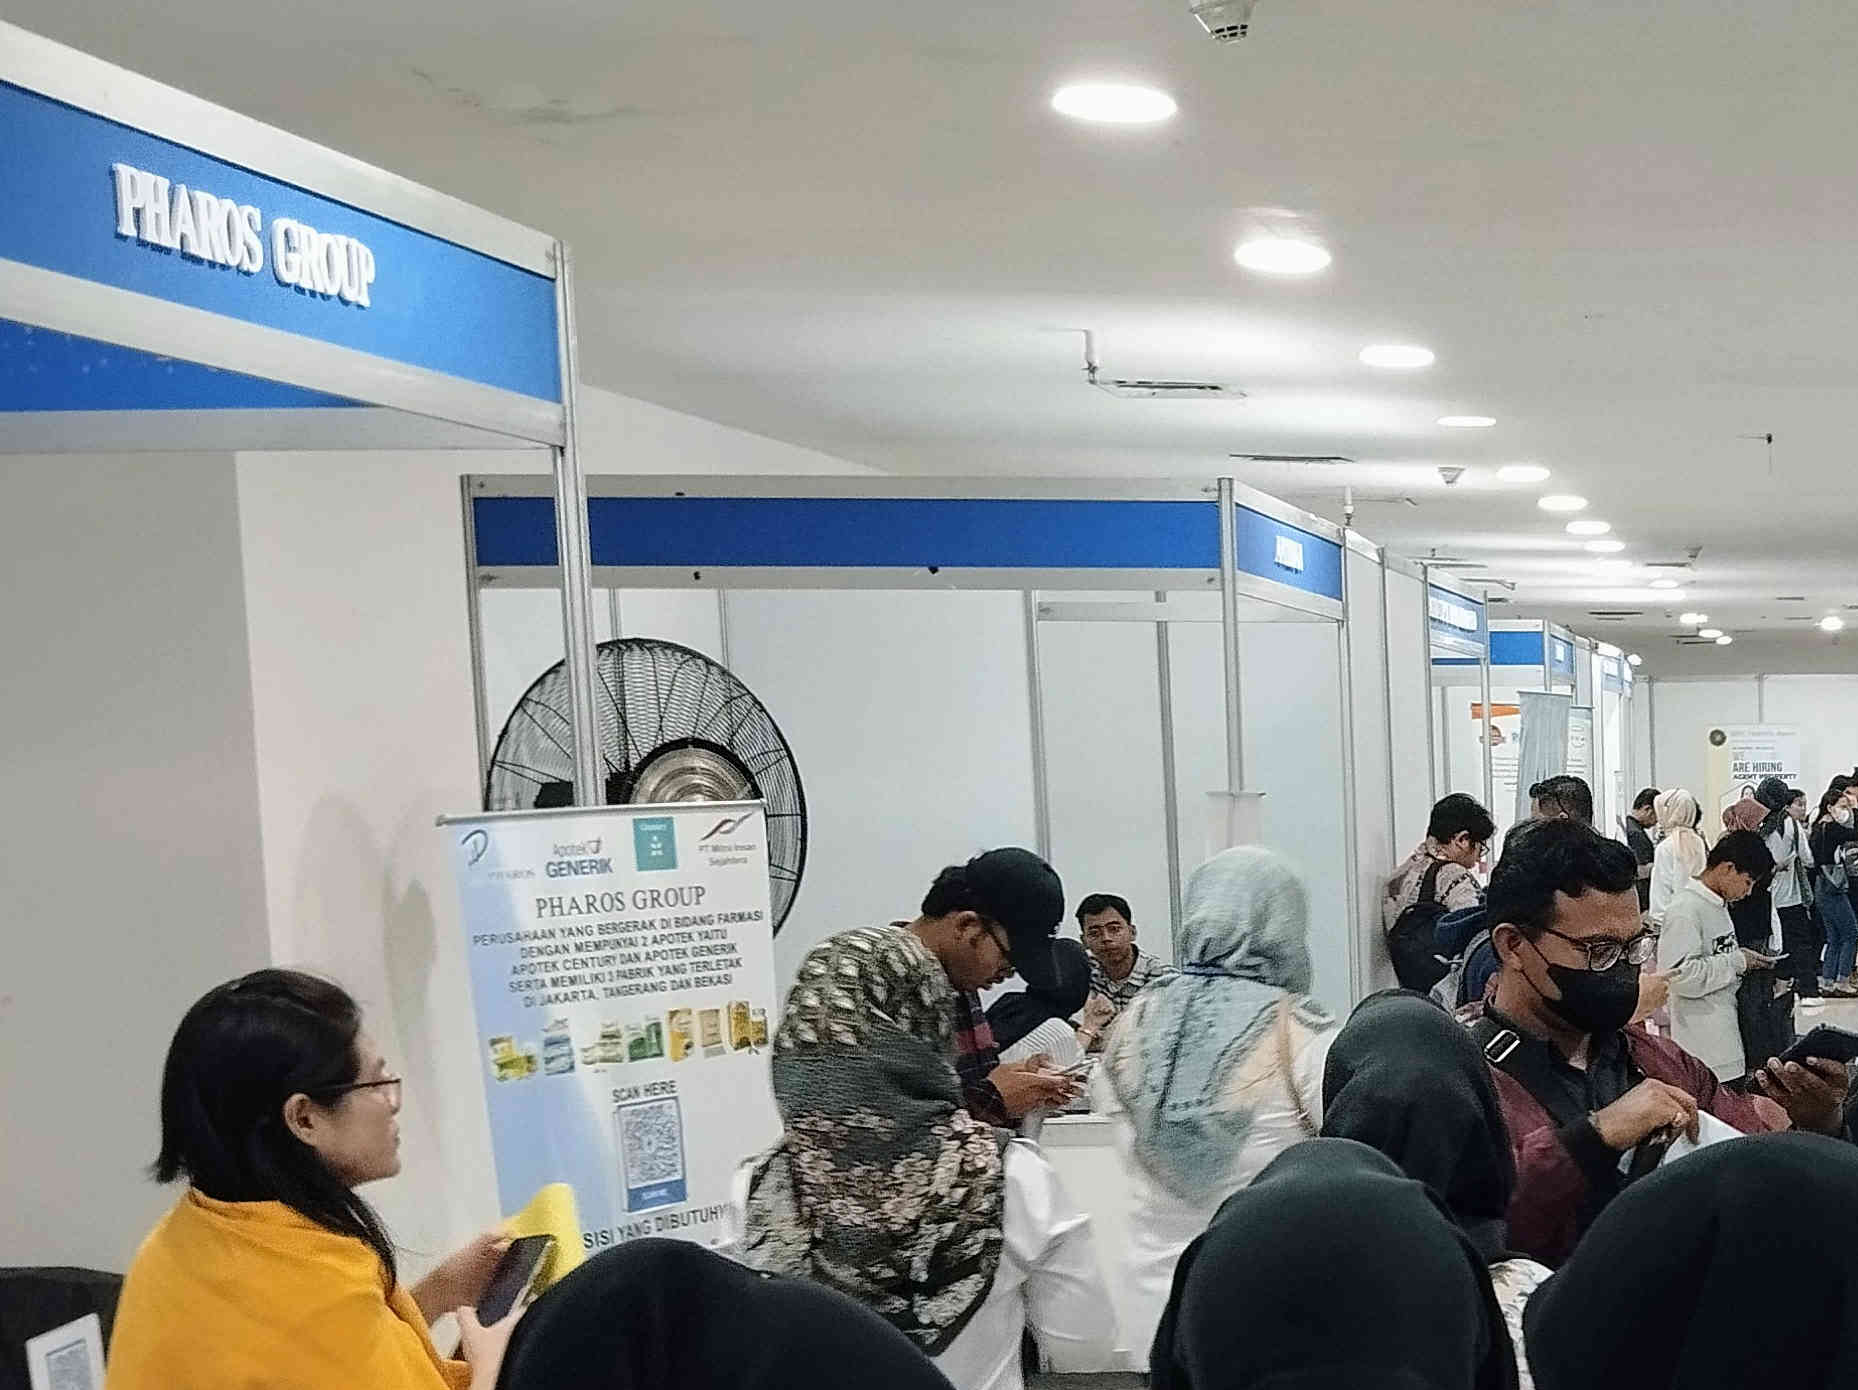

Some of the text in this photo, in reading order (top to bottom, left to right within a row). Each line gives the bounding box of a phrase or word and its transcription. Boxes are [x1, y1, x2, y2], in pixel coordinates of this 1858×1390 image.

[112, 162, 376, 307] PHAROS GROUP
[546, 857, 614, 879] GENERIK
[535, 885, 706, 918] PHAROS GROUP
[472, 910, 764, 946] PERUSAHAAN YANG BERGERAK DI BIDANG FARMASI
[520, 943, 571, 960] DENGAN
[574, 935, 638, 953] MEMPUNYAI
[651, 932, 695, 945] APOTEK
[697, 928, 728, 941] YAITU
[508, 978, 548, 993] SERTA
[550, 970, 605, 988] MEMILIKI
[616, 966, 655, 981] PABRIK
[657, 963, 688, 976] YANG
[689, 957, 744, 973] TERLETAK
[511, 942, 739, 976] APOTEK CENTURY DAN APOTEK GENERIK
[522, 995, 537, 1008] DI
[602, 980, 668, 999] TANGERANG
[670, 977, 692, 991] DAN
[694, 973, 733, 988] BEKASI
[612, 1080, 677, 1102] SCAN HERE
[583, 1205, 727, 1249] SISI YANG DIBUTUH
